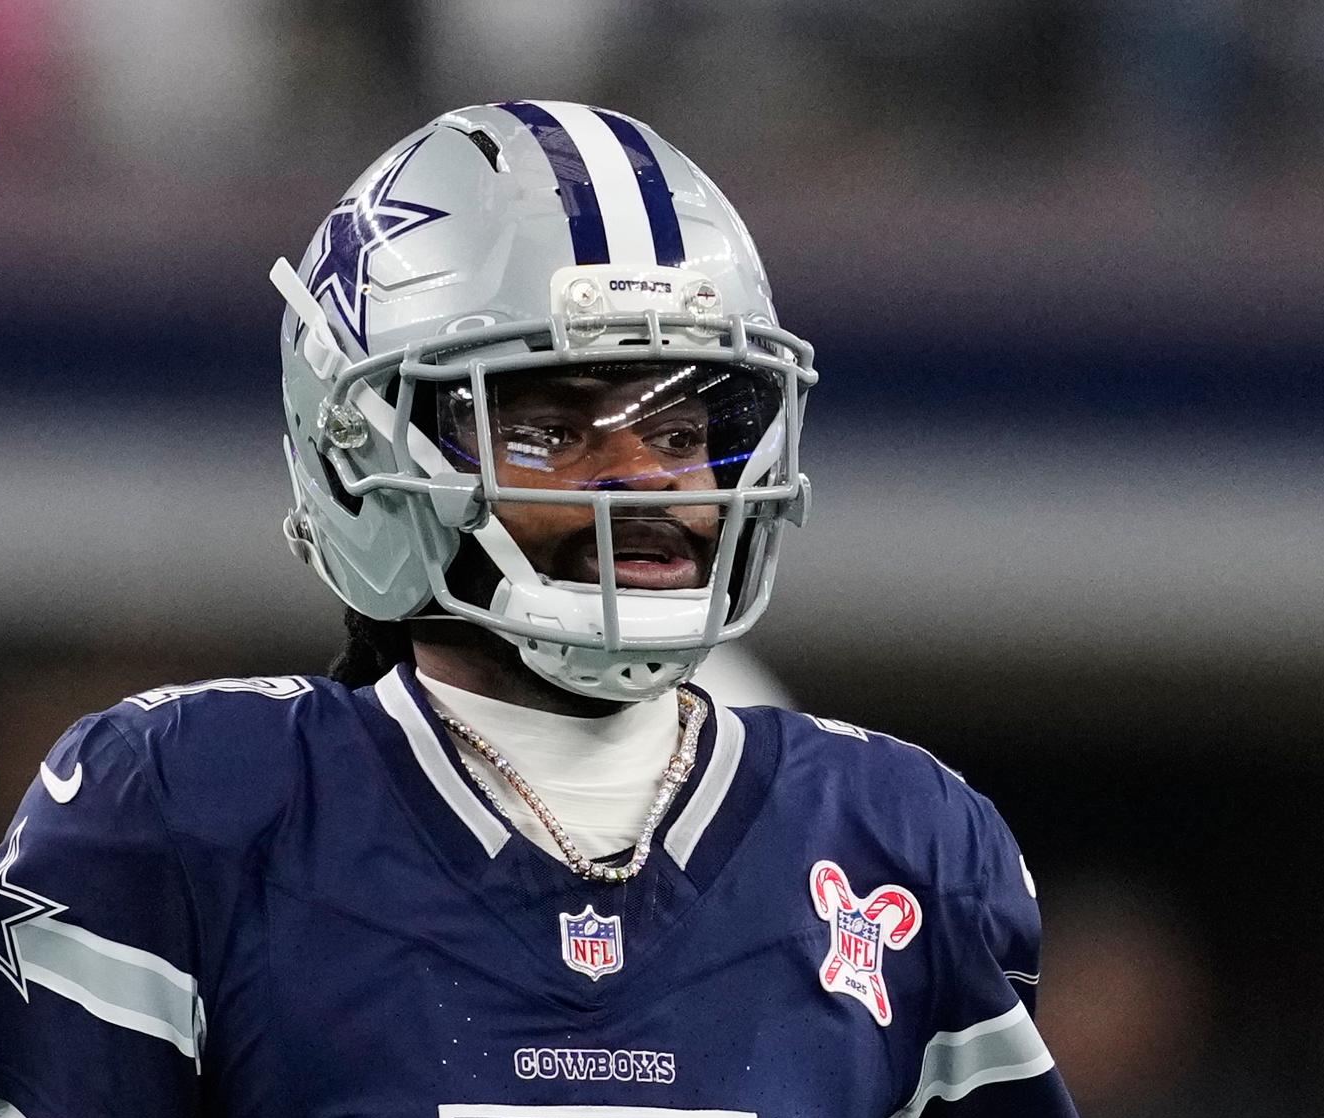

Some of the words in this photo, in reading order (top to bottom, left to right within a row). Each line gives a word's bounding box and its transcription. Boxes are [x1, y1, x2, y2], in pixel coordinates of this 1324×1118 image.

[572, 938, 615, 967] NFL
[840, 931, 873, 967] NFL
[845, 976, 867, 995] 2025
[513, 1048, 676, 1084] COWBOYS
